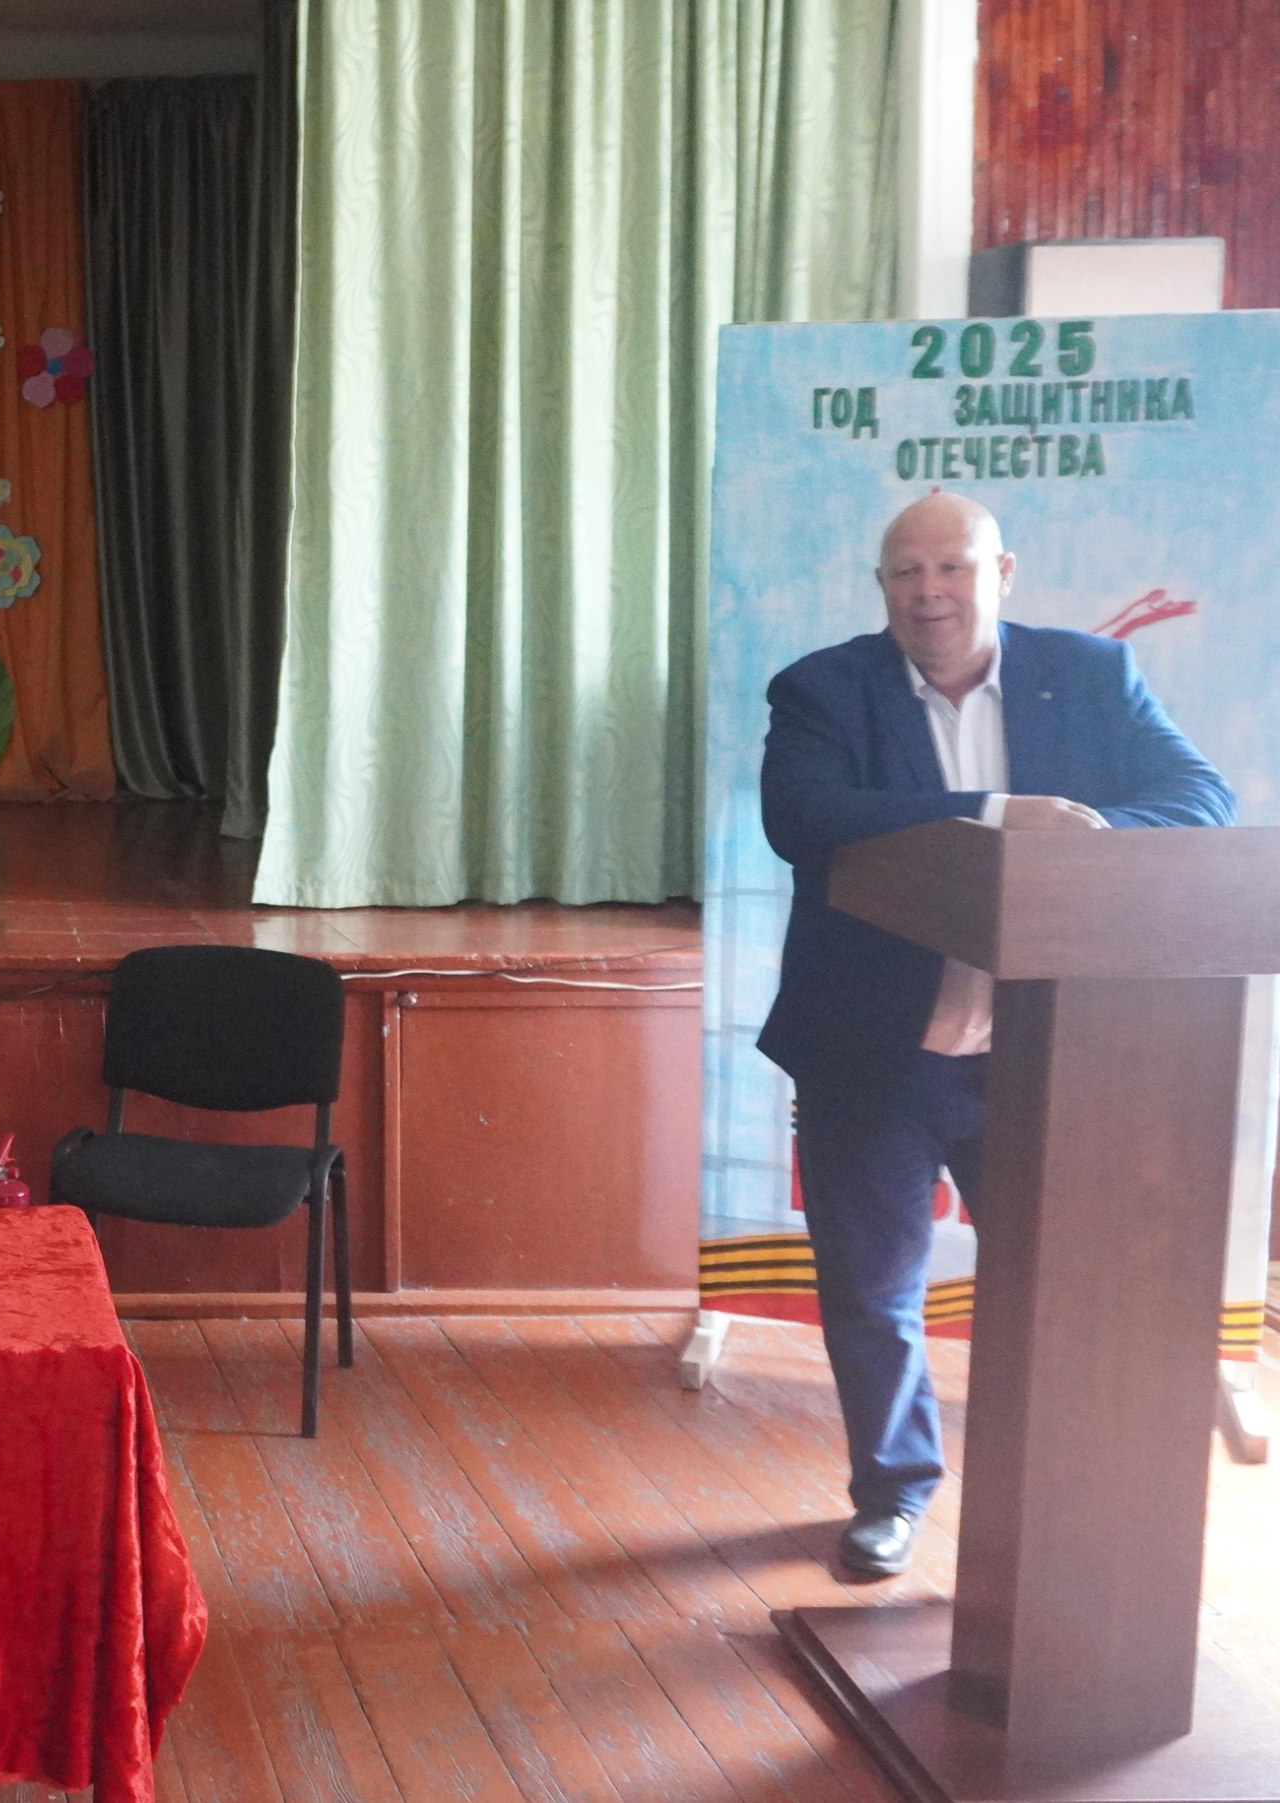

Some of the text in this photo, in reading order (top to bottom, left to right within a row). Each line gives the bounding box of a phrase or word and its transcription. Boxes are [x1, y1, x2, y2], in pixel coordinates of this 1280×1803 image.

[911, 320, 1097, 379] 2025
[813, 377, 1195, 439] ГОД ЗАЩИТНИКА
[896, 433, 1107, 481] ОТЕЧЕСТВА
